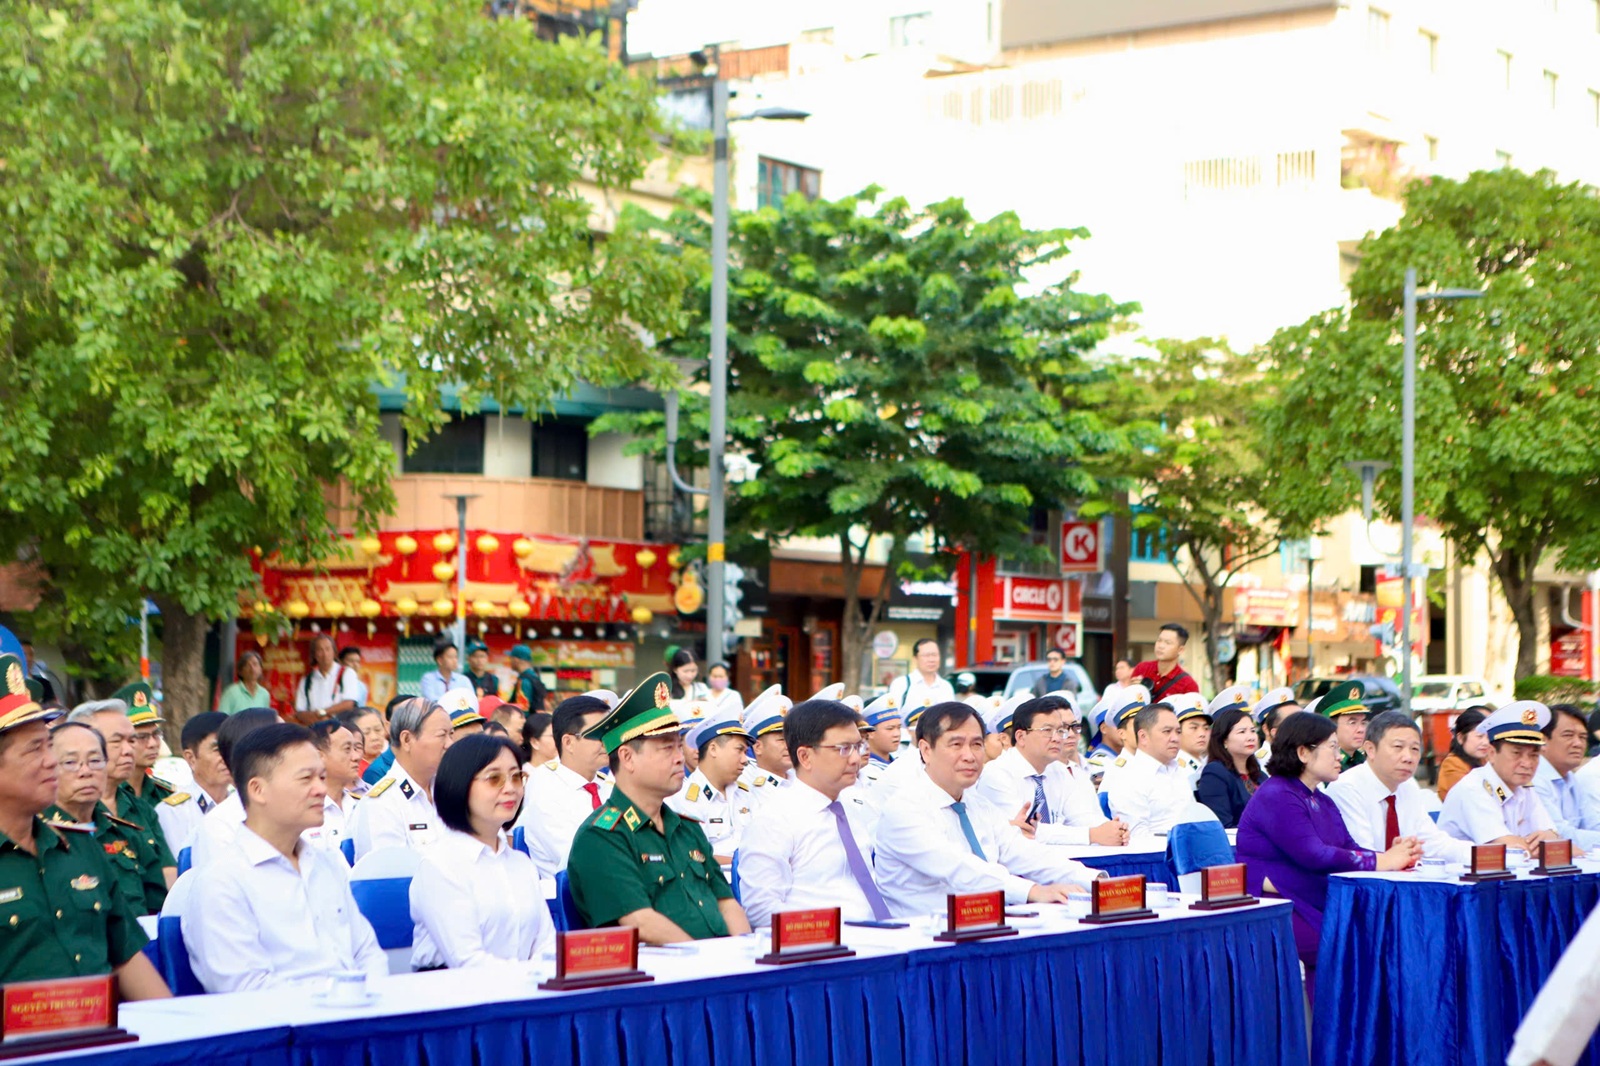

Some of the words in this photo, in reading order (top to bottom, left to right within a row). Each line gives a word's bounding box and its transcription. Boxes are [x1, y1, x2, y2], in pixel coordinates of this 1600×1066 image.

[1012, 586, 1046, 605] CIRCLE
[12, 1001, 47, 1013] NGUYỄN
[50, 999, 78, 1010] TRUNG
